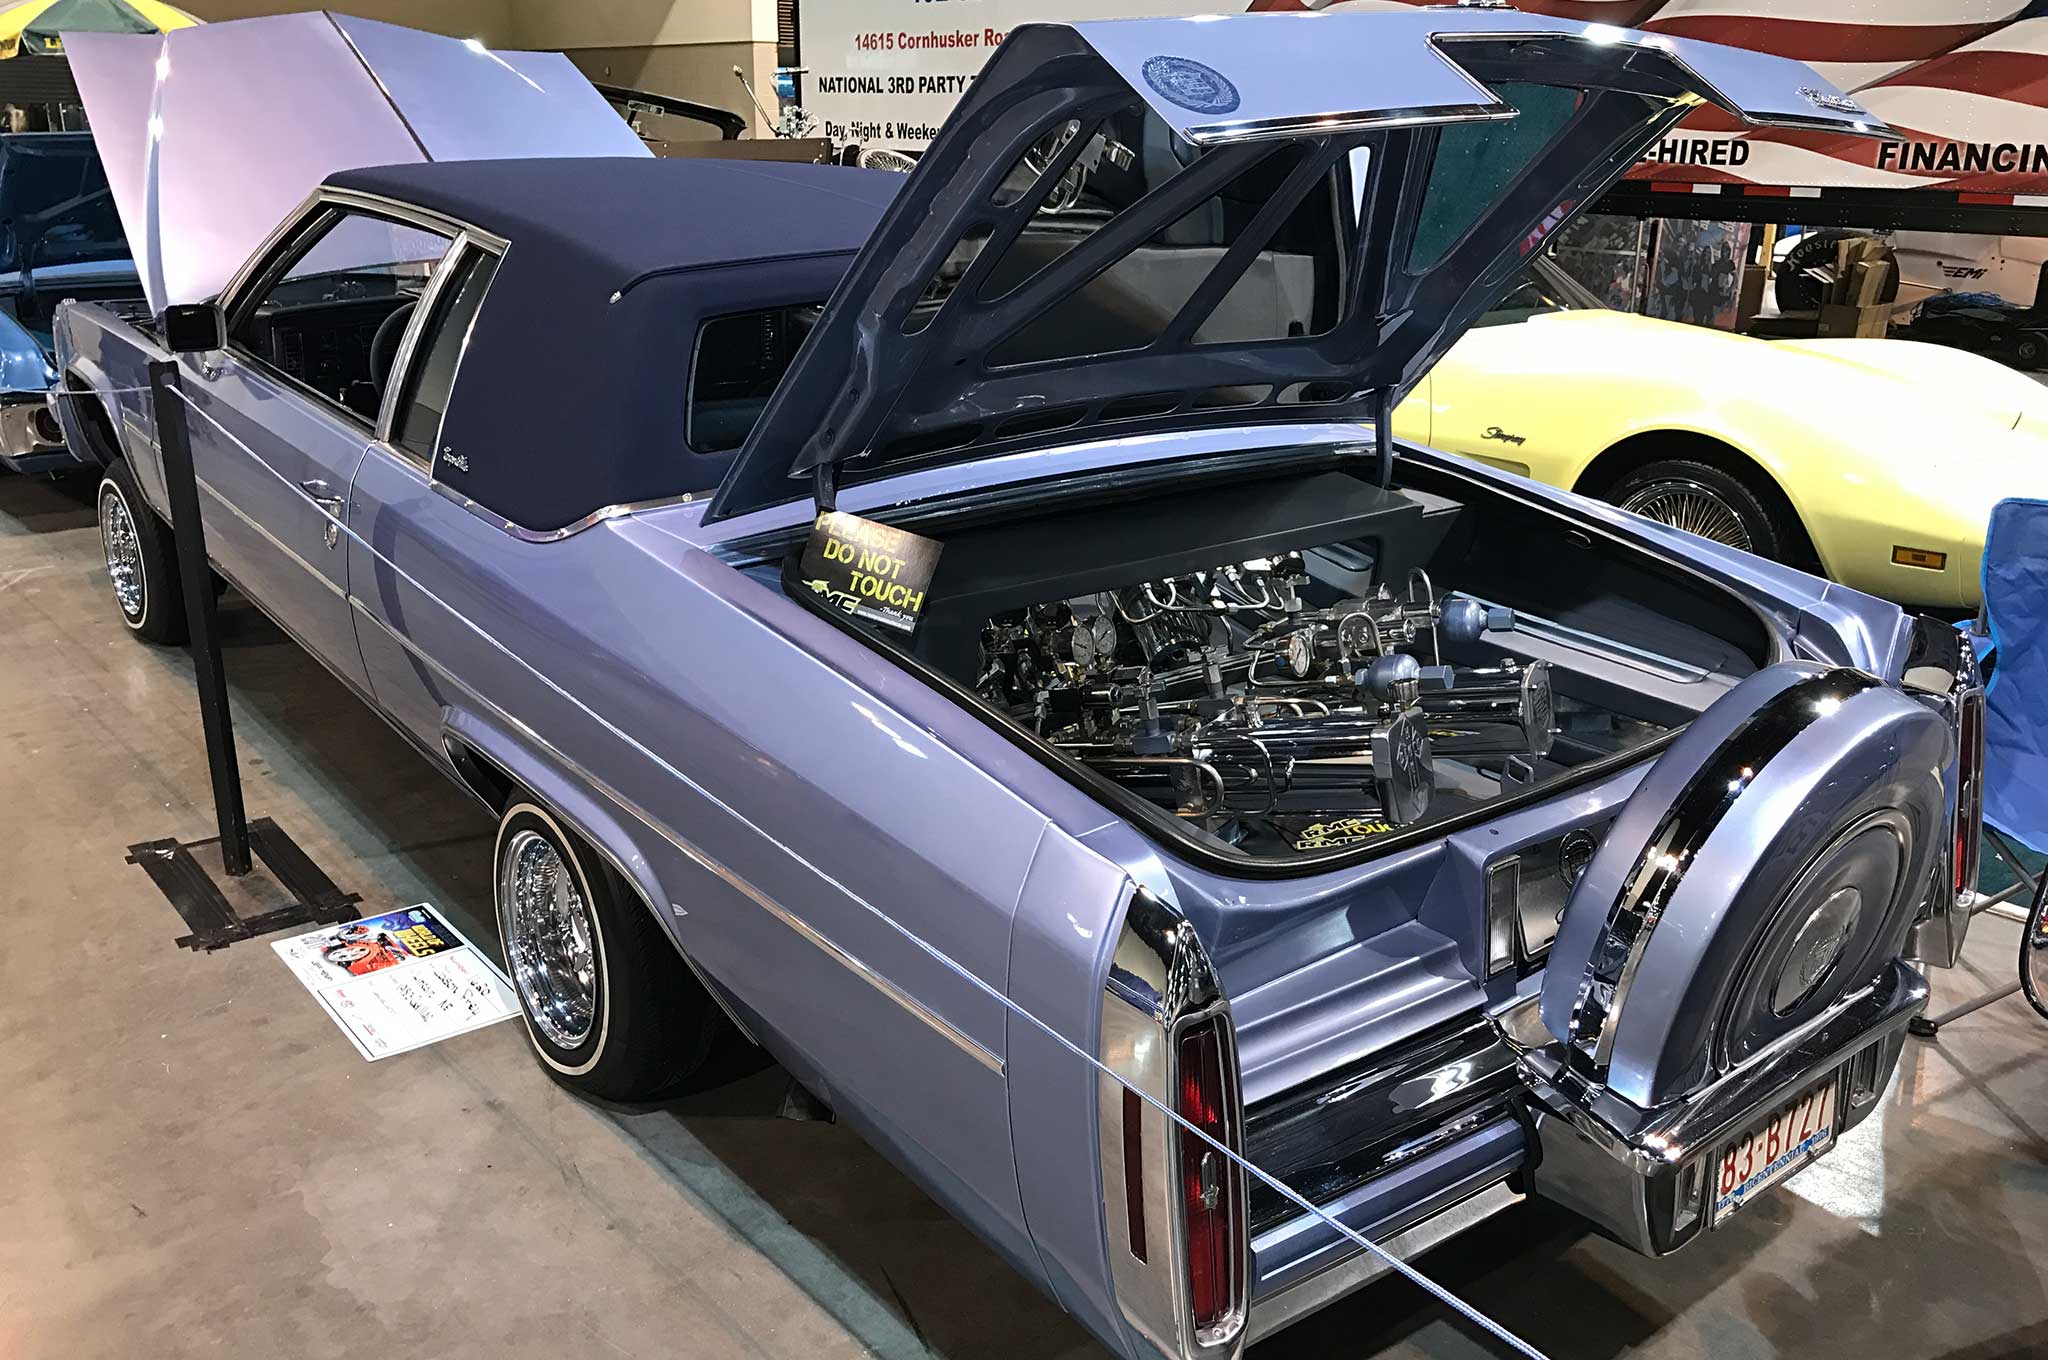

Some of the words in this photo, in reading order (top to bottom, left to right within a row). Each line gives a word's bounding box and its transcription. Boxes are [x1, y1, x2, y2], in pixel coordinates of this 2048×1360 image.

[855, 33, 894, 50] 14615
[898, 30, 979, 49] Cornhusker
[819, 77, 884, 93] NATIONAL
[888, 77, 914, 94] 3RD
[919, 76, 966, 93] PARTY
[852, 121, 882, 142] Night
[885, 122, 894, 139] &
[897, 122, 940, 140] Weeke
[1637, 139, 1750, 166] -HIRED
[1877, 142, 2048, 173] FINANCIN
[823, 537, 855, 564] DO
[858, 549, 906, 580] NOT
[849, 570, 924, 612] TOUCH
